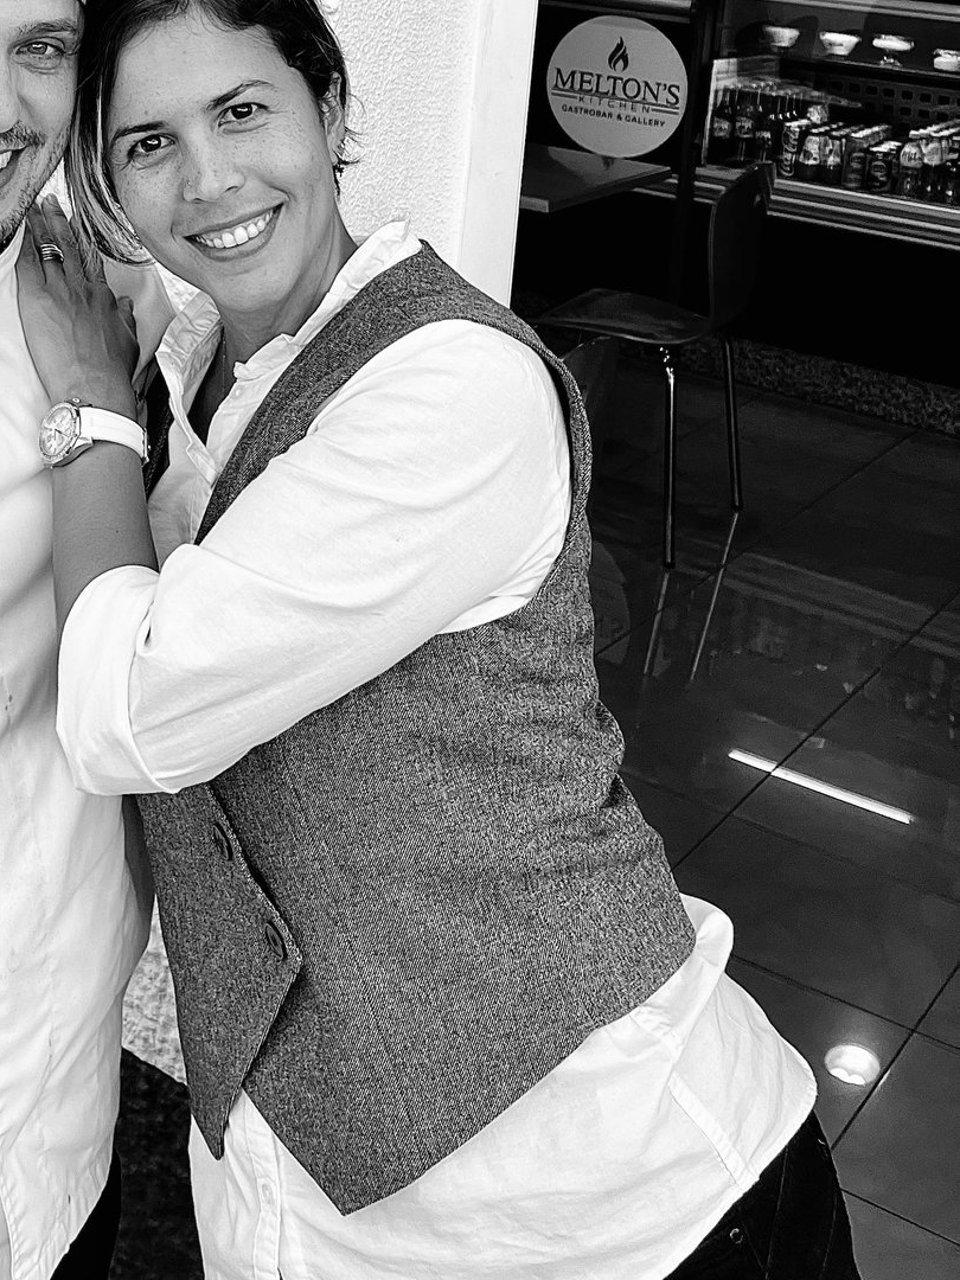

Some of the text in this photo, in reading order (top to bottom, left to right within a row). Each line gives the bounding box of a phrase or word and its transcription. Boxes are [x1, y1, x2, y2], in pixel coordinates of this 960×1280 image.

[553, 67, 680, 106] MELTON'S
[561, 103, 666, 128] GASTROBAR & GALLERY
[578, 95, 651, 114] KITCHEN
